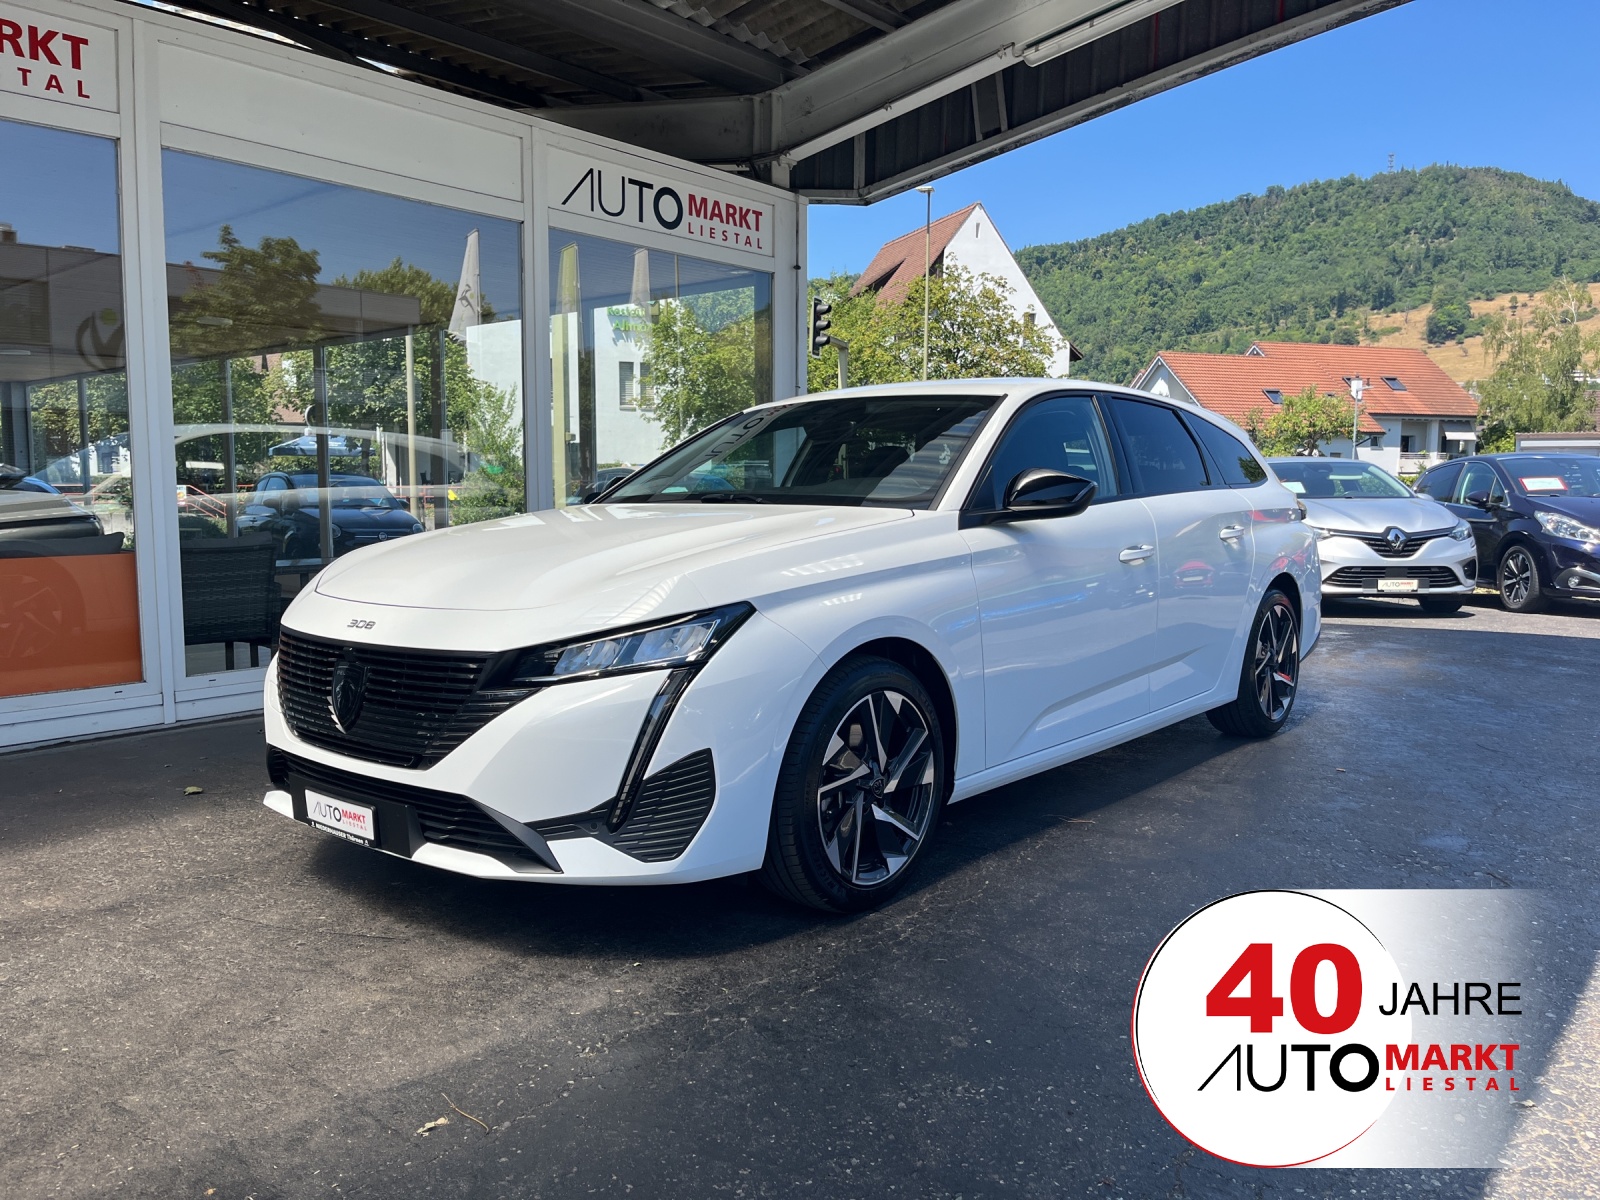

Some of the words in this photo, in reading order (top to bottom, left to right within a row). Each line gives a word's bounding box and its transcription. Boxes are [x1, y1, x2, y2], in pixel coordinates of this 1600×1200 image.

[561, 167, 684, 230] AUTO
[688, 193, 763, 232] MARKT
[688, 222, 763, 249] LIESTAL
[347, 618, 377, 630] 308
[313, 801, 342, 823] AUTO
[342, 809, 366, 824] MARKT
[342, 820, 368, 831] LIESTAL
